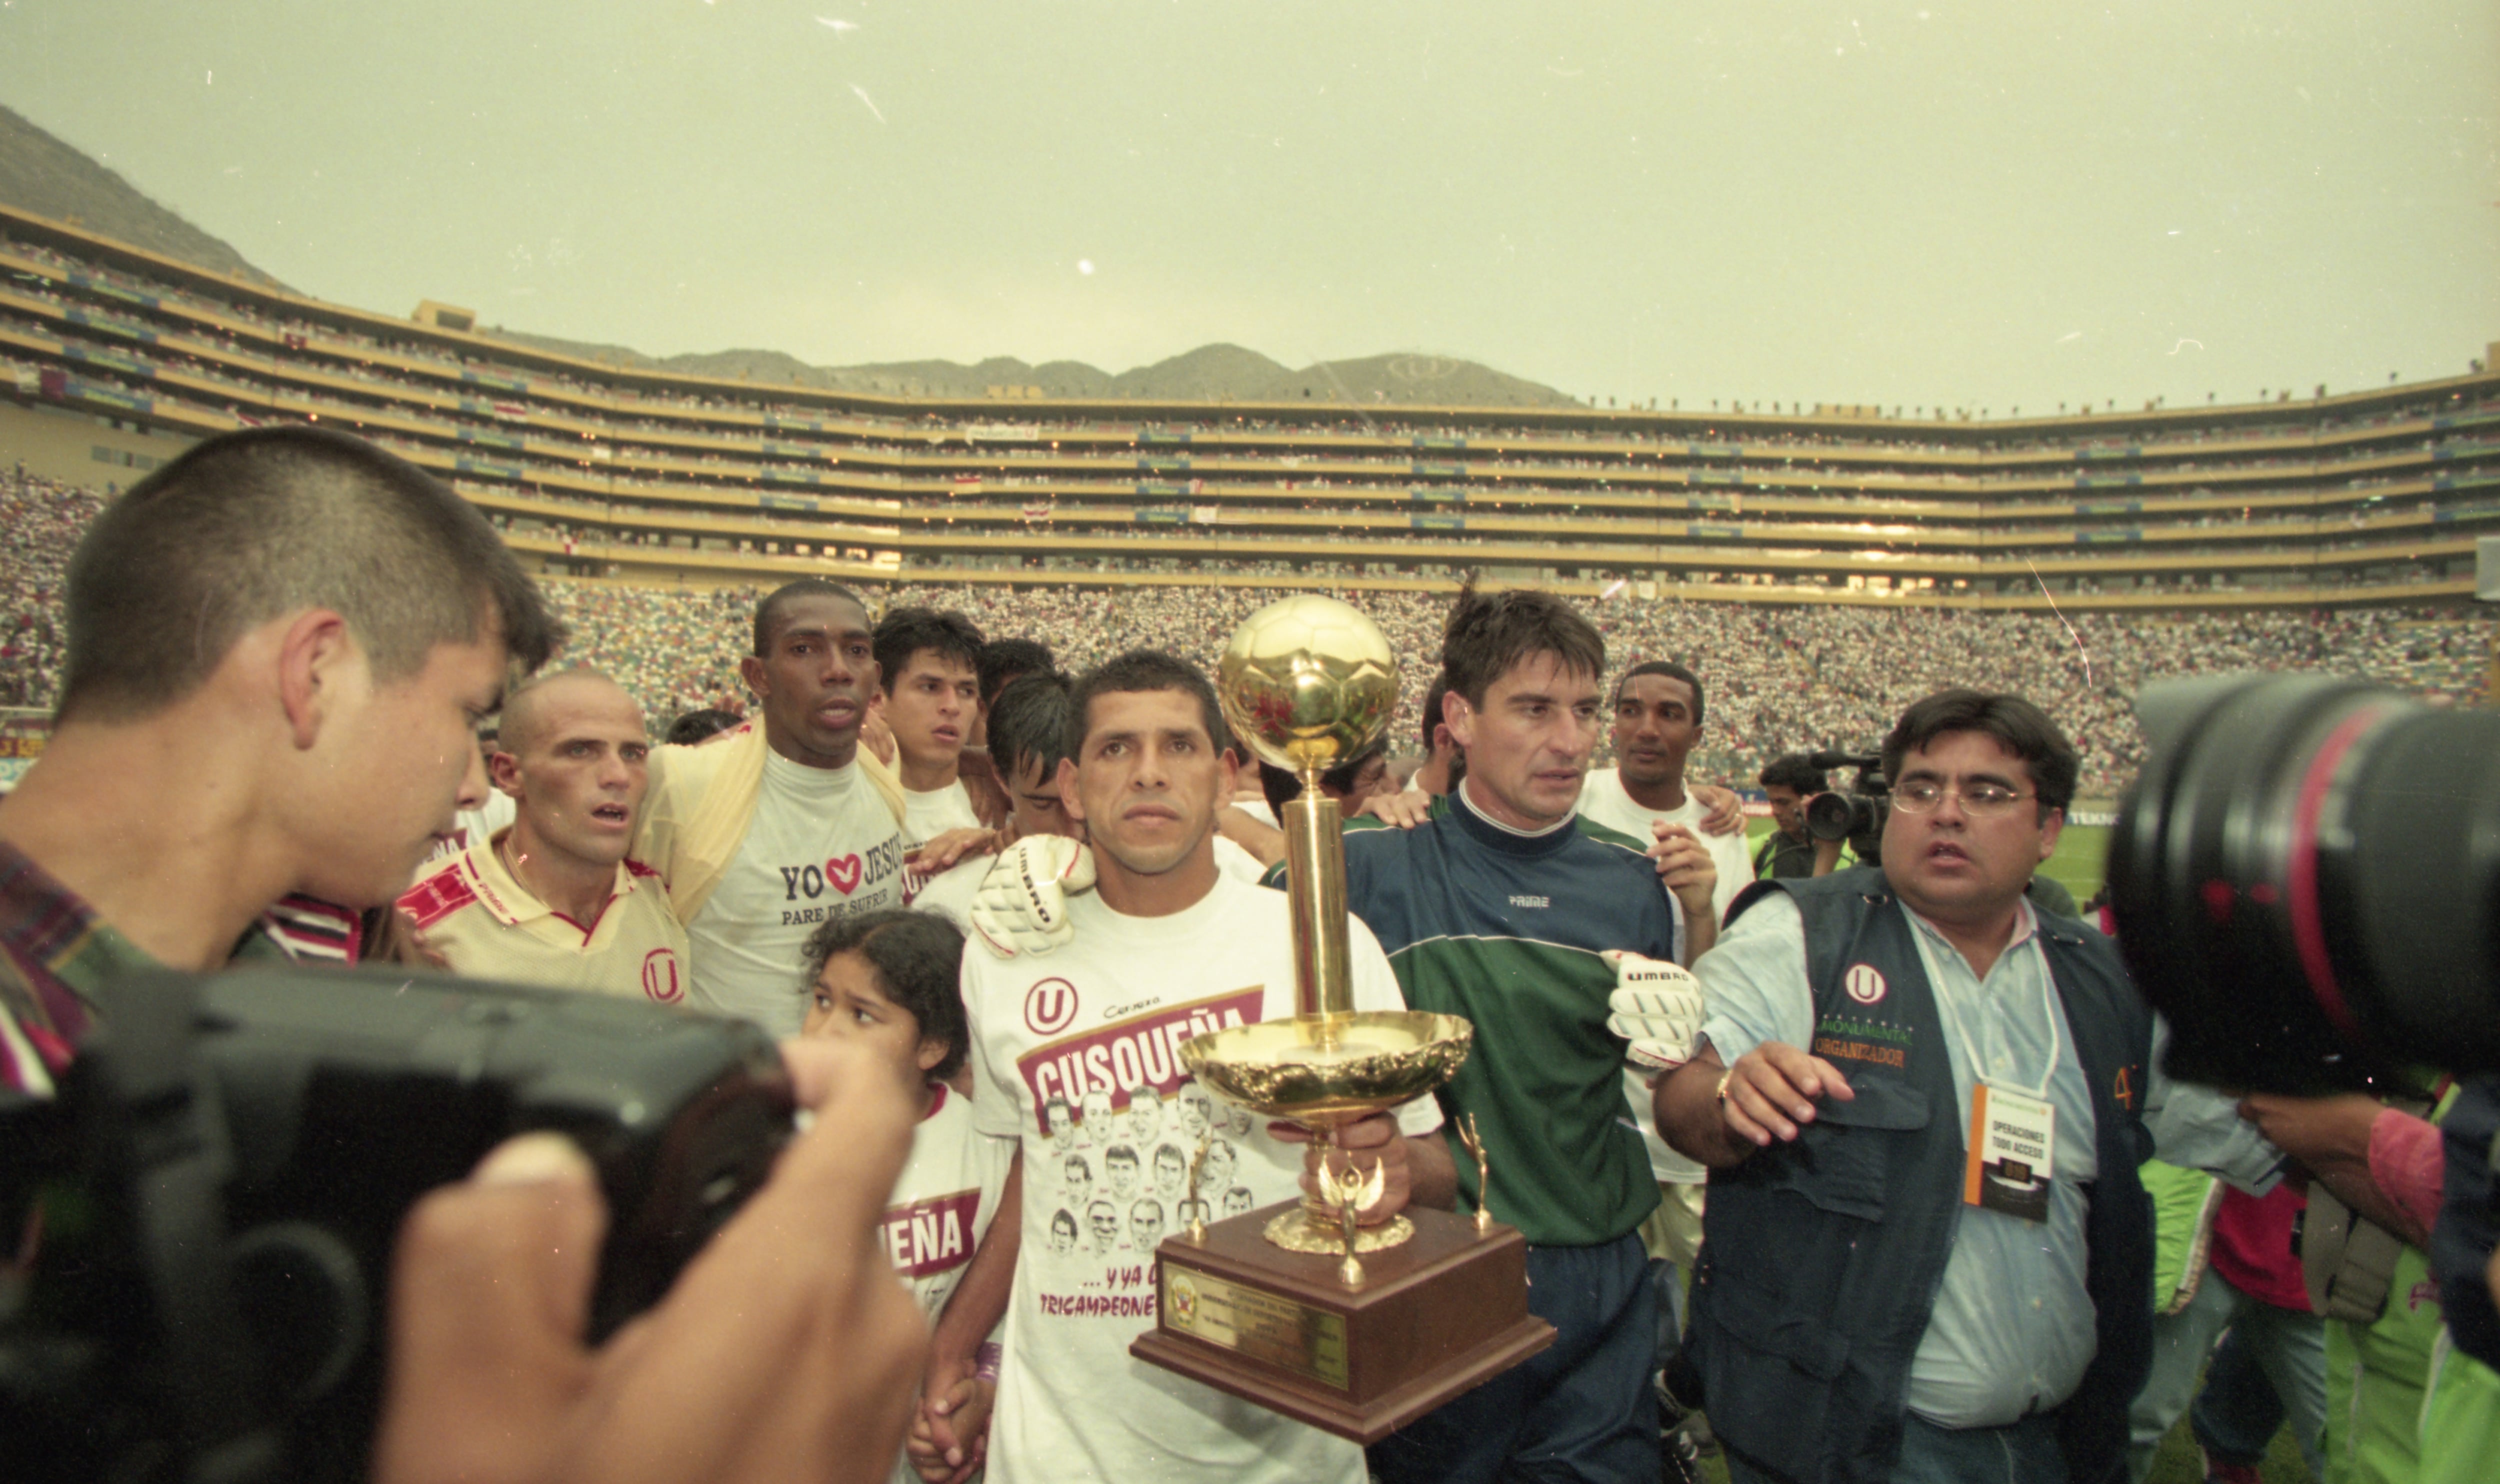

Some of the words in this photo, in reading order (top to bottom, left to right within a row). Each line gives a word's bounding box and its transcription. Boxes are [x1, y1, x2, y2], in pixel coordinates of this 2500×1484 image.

[780, 864, 824, 900] YO
[782, 908, 824, 925] PARE
[850, 888, 887, 914] SUFRIR
[1628, 972, 1688, 981] UMBRO
[1816, 1038, 1904, 1068] ORGANIZADOR
[1993, 1120, 2044, 1144] OPERACIONES
[1992, 1136, 2011, 1150] TODO
[2014, 1142, 2044, 1160] ACCESO
[1121, 1265, 1142, 1290] YA
[1040, 1293, 1155, 1317] TRICAMPEONE
